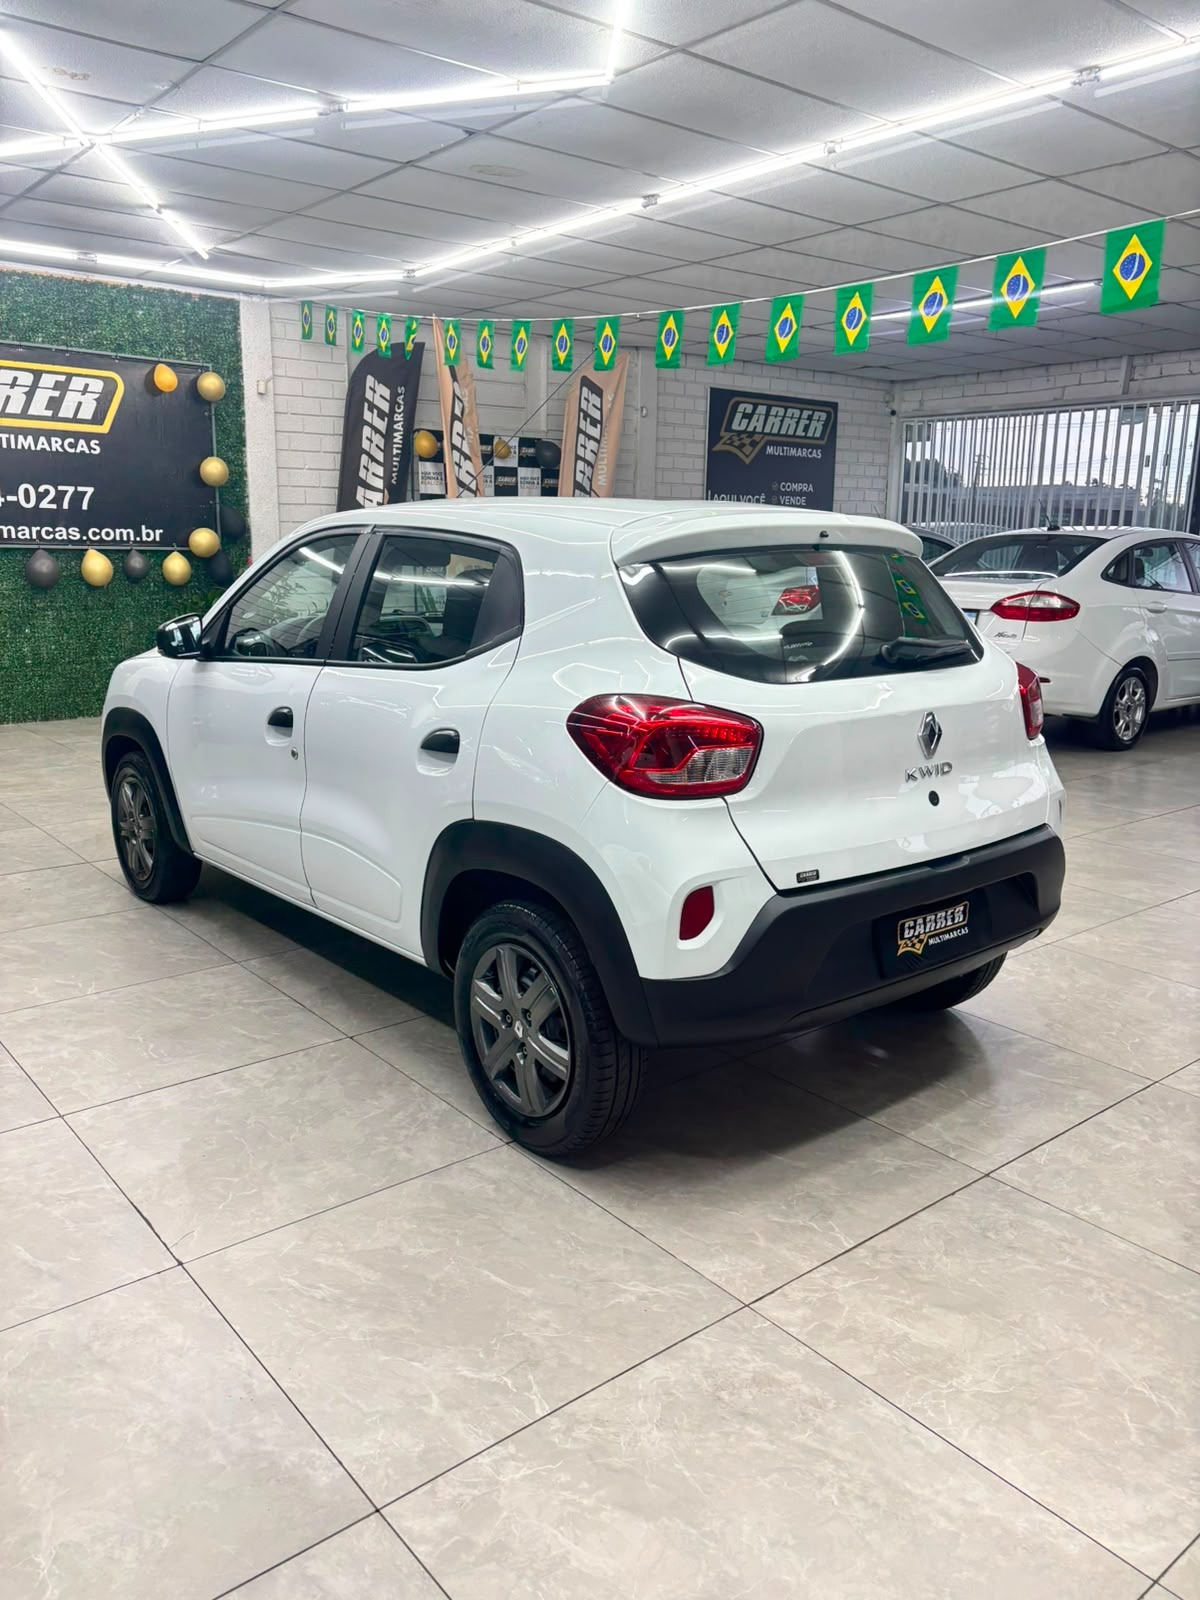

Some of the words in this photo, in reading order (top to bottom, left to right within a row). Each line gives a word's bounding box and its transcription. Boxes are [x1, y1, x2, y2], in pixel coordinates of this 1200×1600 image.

[731, 402, 828, 438] CARRER
[392, 386, 406, 485] MULTIMARCAS
[766, 445, 822, 459] MULTIMARCAS
[0, 483, 94, 510] -0277
[780, 482, 814, 493] COMPRA
[780, 496, 807, 506] VENDE
[905, 761, 953, 783] KWID
[903, 906, 965, 938] CARRER
[928, 926, 969, 946] MULTIMARCAS
